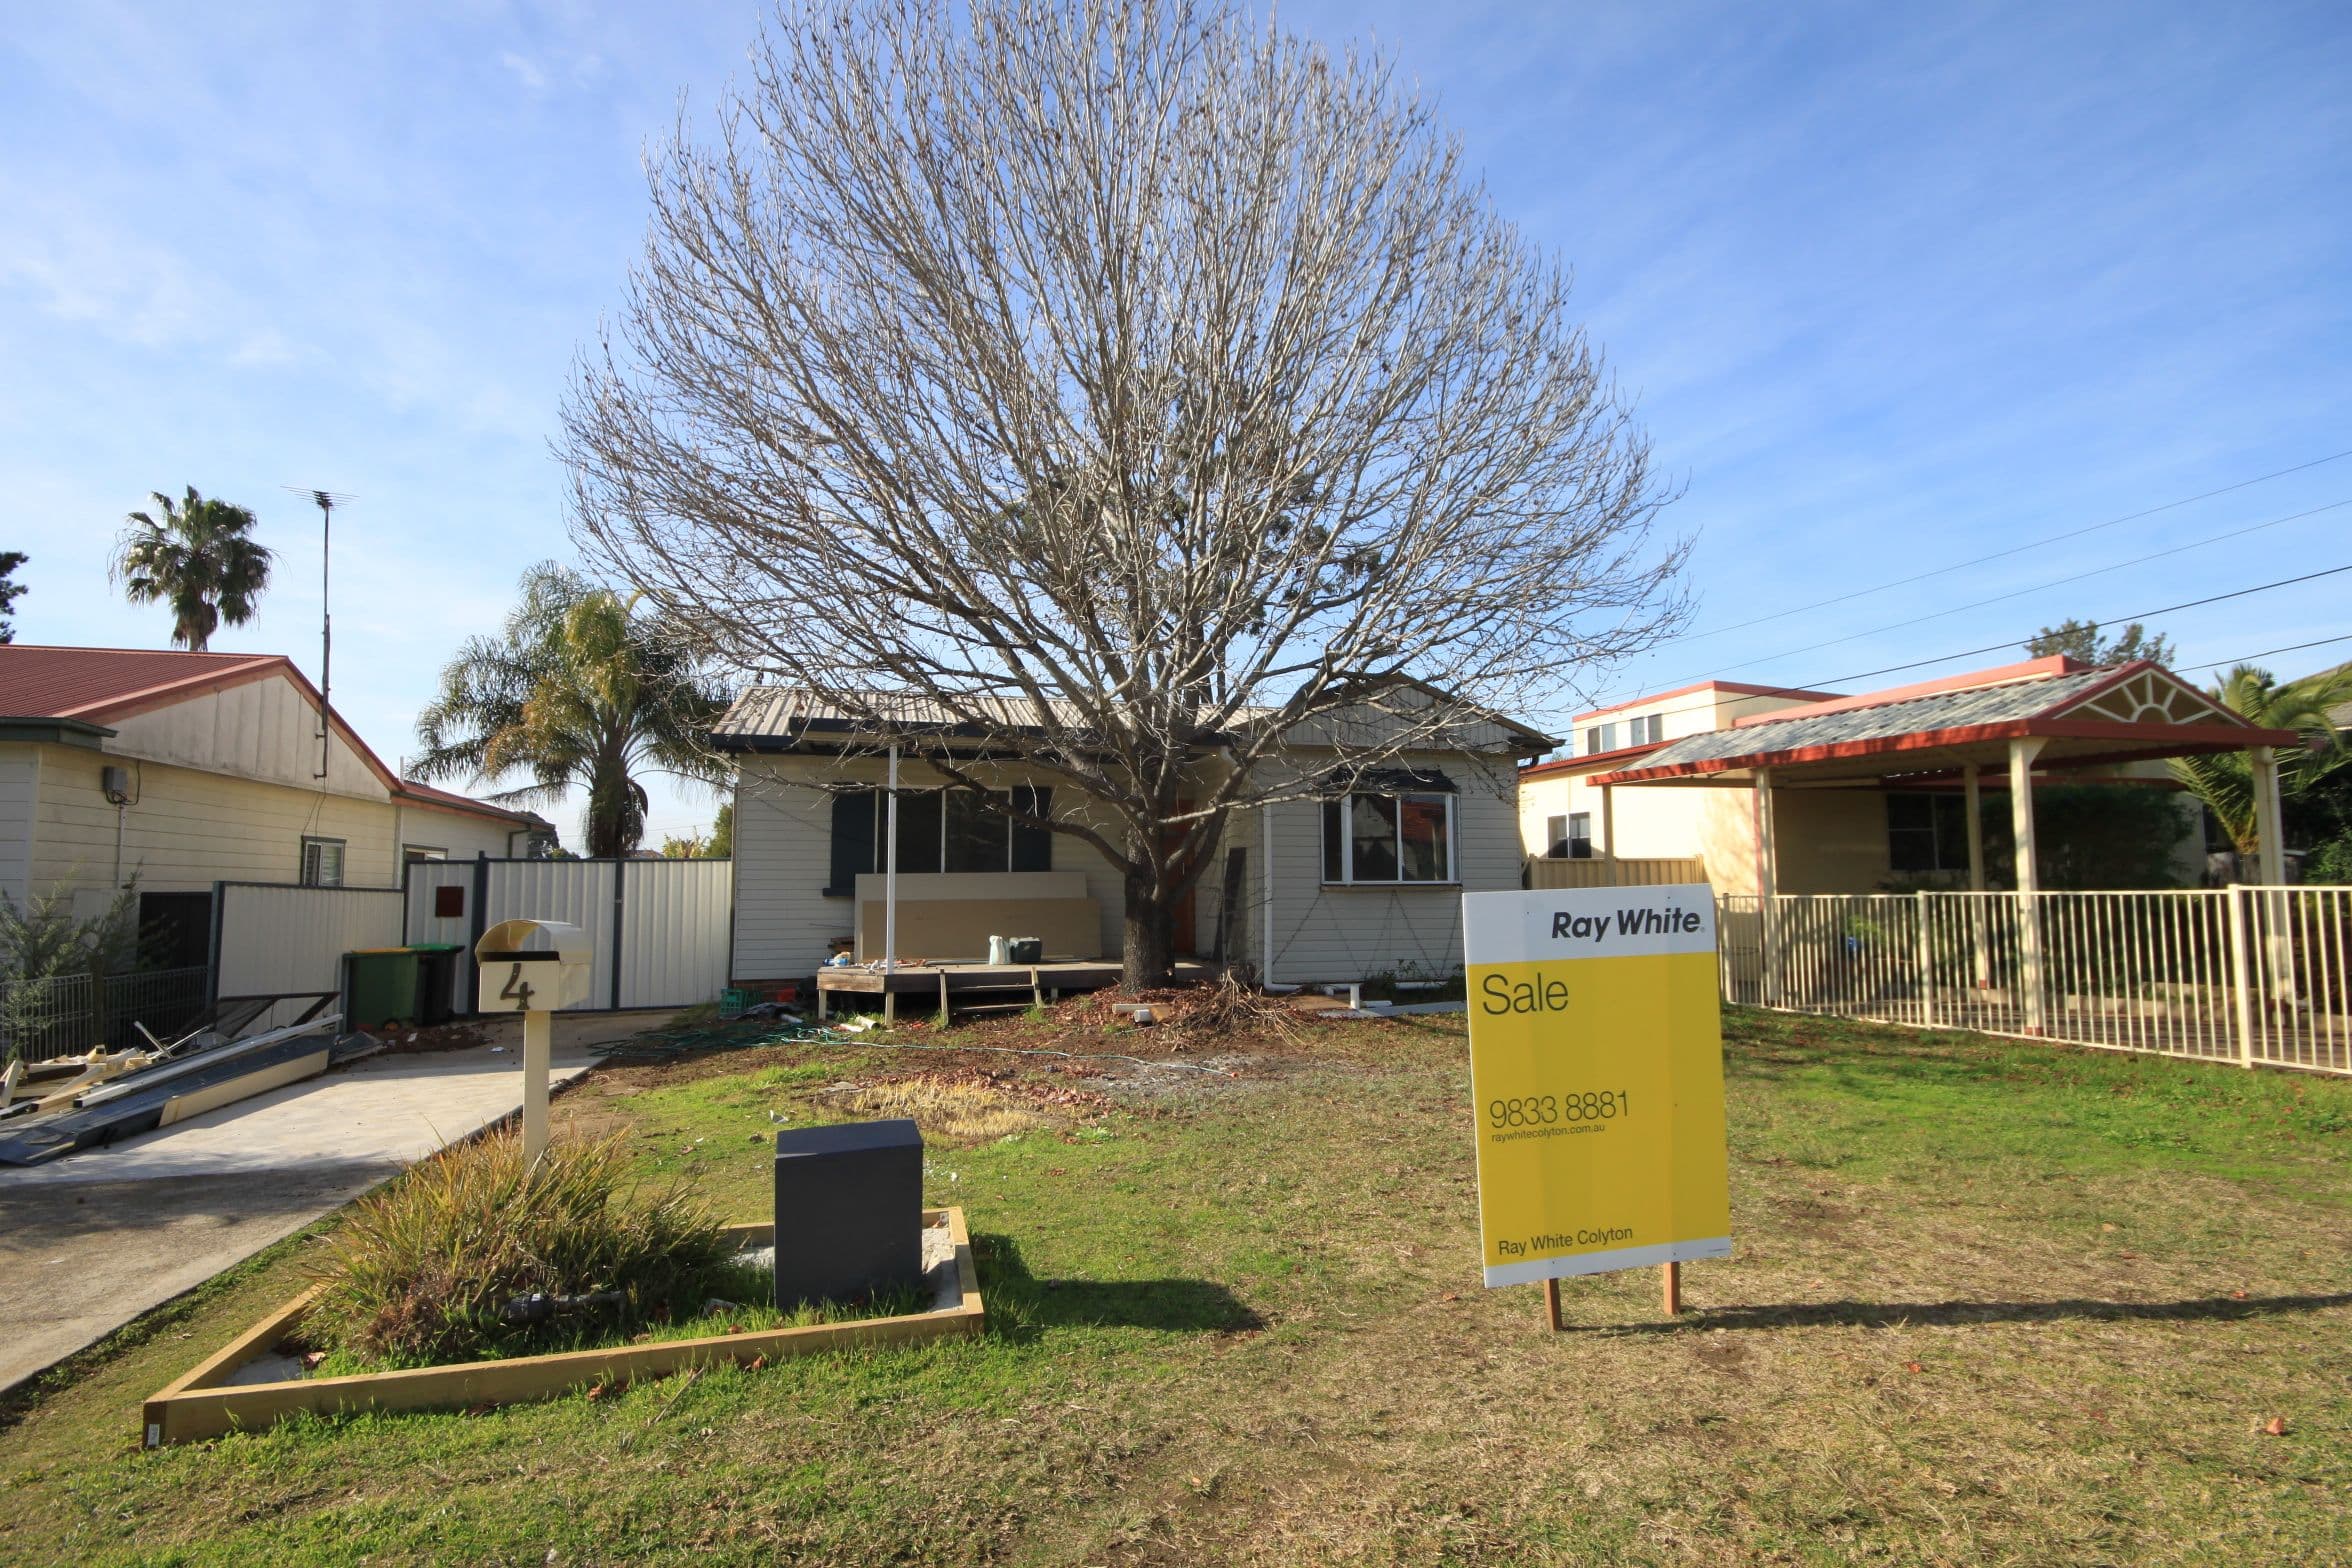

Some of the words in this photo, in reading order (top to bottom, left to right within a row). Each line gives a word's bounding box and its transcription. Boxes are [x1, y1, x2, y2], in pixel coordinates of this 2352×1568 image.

[1551, 911, 1611, 942] Ray
[1617, 907, 1701, 936] White
[499, 962, 536, 1010] 4
[1482, 972, 1569, 1015] Sale
[1489, 1095, 1558, 1129] 9833
[1566, 1089, 1629, 1122] 8881
[1491, 1122, 1606, 1143] raywhitecolyton.com.au
[1498, 1240, 1527, 1257] Ray
[1530, 1234, 1573, 1251] White
[1577, 1226, 1633, 1245] Colyton
